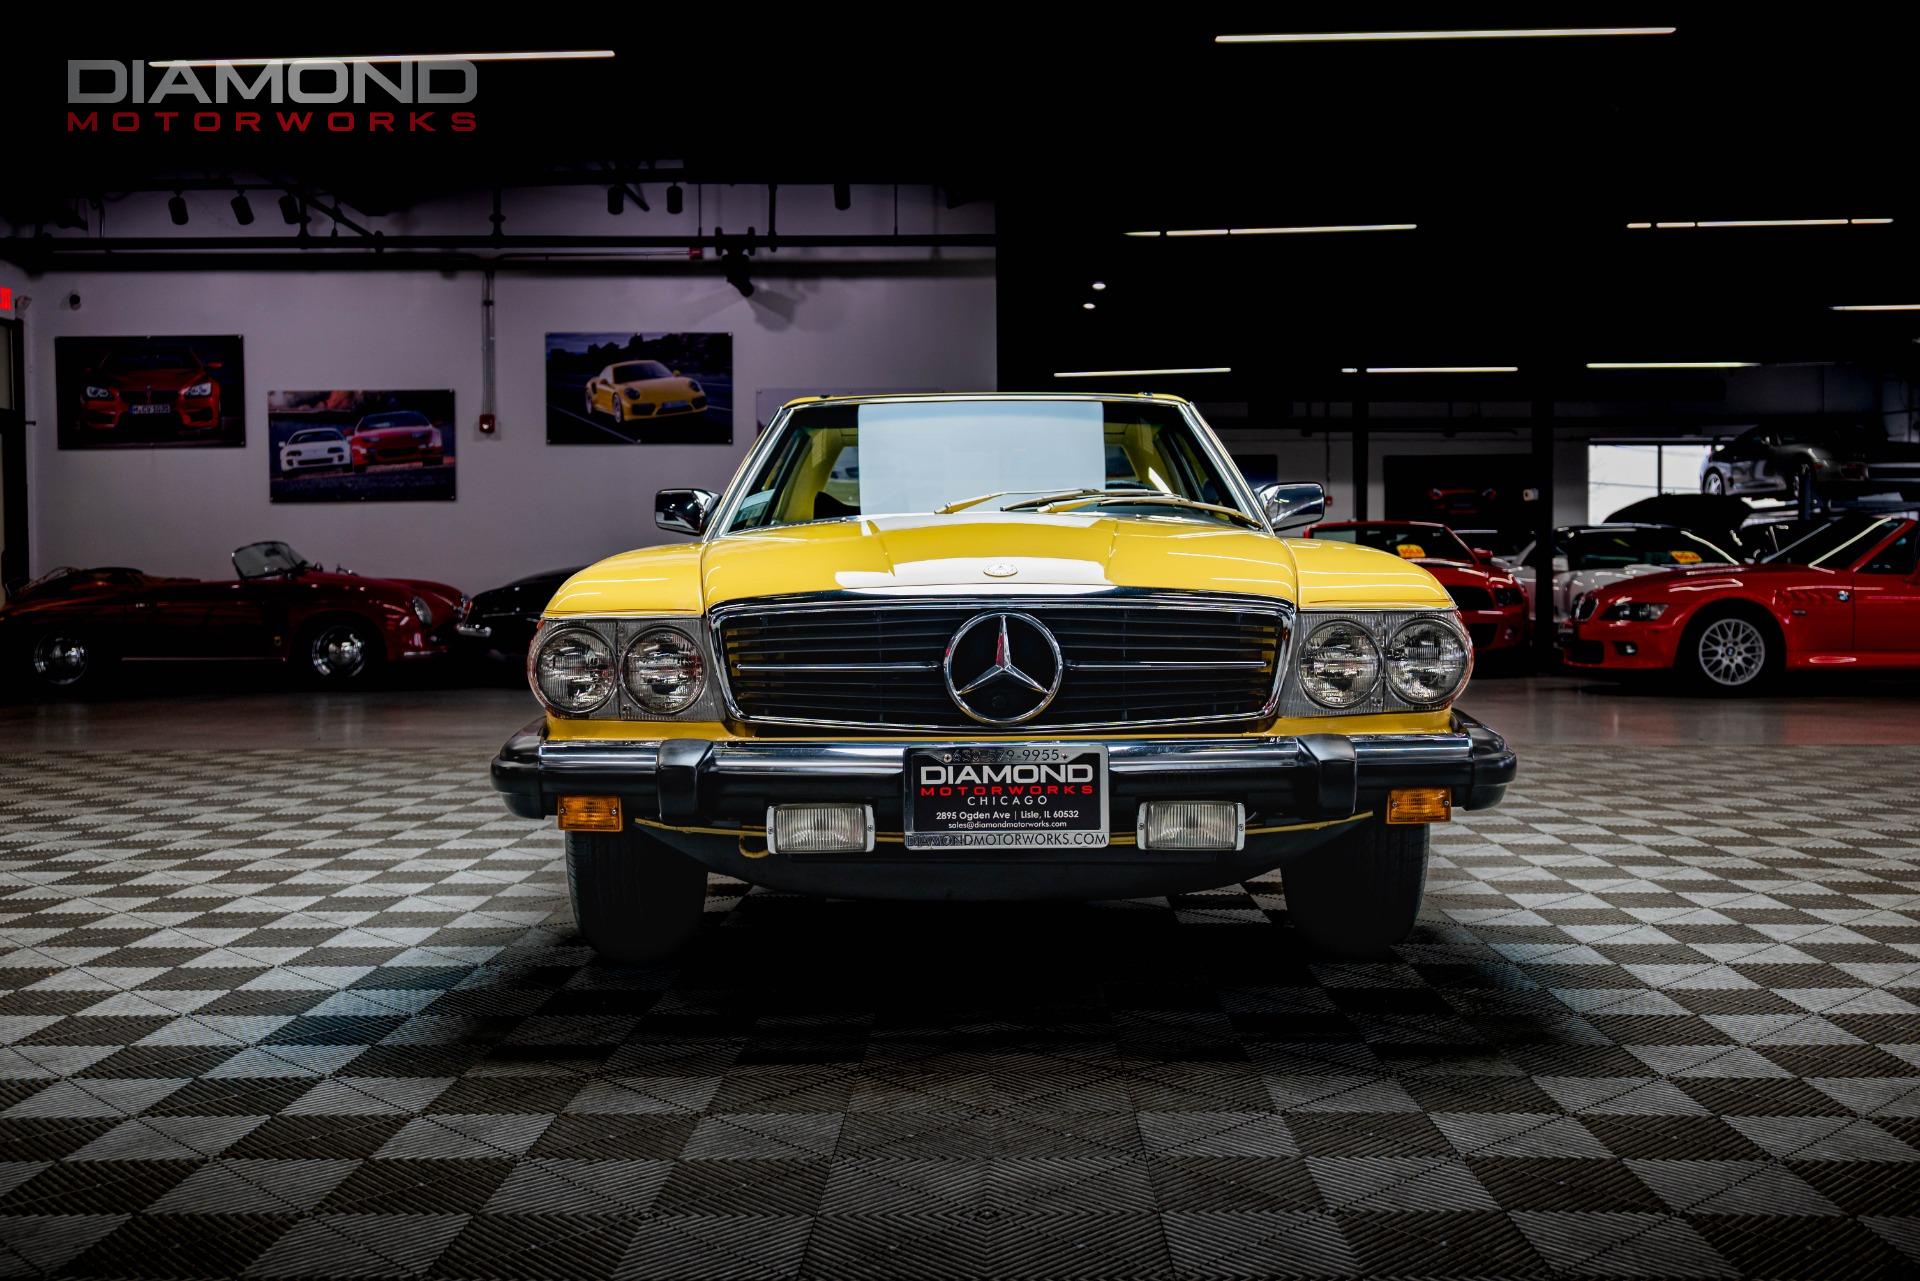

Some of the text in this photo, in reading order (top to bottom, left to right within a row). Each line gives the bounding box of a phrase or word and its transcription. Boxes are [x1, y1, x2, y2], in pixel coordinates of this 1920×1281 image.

[920, 764, 1094, 785] DIAMOND
[920, 785, 1093, 797] MOTORWORKS
[967, 796, 1048, 806] CHICAGO
[936, 810, 1079, 821] 2895 Ogden Ave Lisle, IL 60532
[948, 820, 1067, 830] sales@diamondmotorworks.com
[907, 832, 1106, 847] DIAMONDMOTORWORKS.COM
